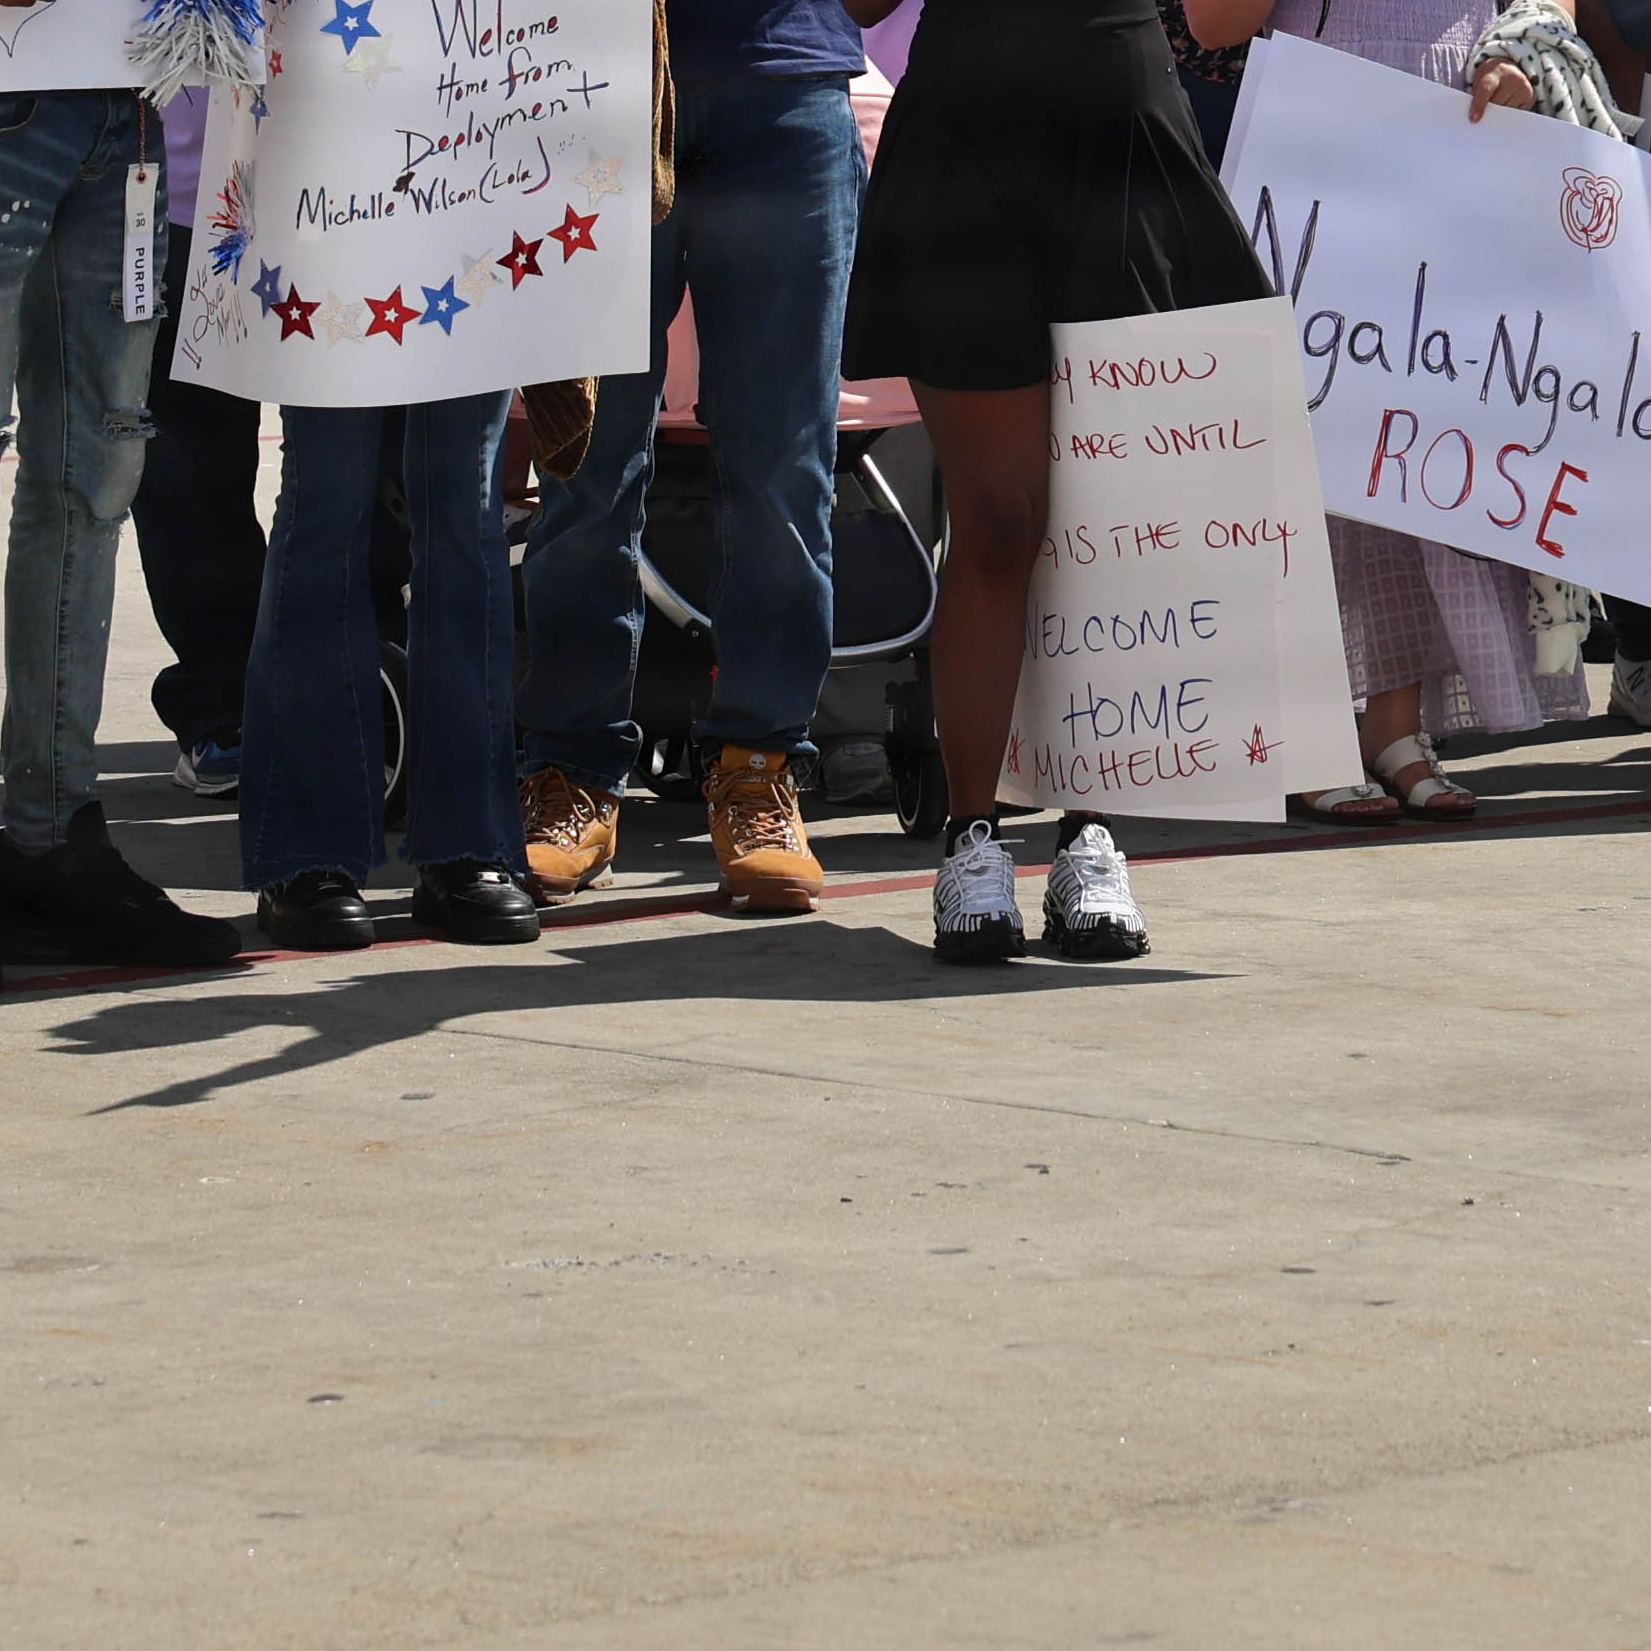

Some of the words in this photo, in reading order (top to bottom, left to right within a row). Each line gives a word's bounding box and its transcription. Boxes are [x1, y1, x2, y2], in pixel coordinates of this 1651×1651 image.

[436, 61, 488, 117] Home
[395, 70, 609, 173] Deployment
[295, 186, 396, 233] Michelle
[407, 177, 477, 216] Wilson
[134, 247, 146, 316] PURPLE
[1089, 351, 1218, 391] KNOW
[1070, 432, 1129, 461] ARE
[1145, 419, 1267, 458] UNTIL
[1367, 407, 1590, 559] ROSE
[1065, 524, 1097, 566] IS
[1109, 519, 1182, 559] THE
[1204, 518, 1298, 579] ONLY
[1062, 677, 1214, 749] HOME
[1034, 737, 1221, 796] MICHELLE
